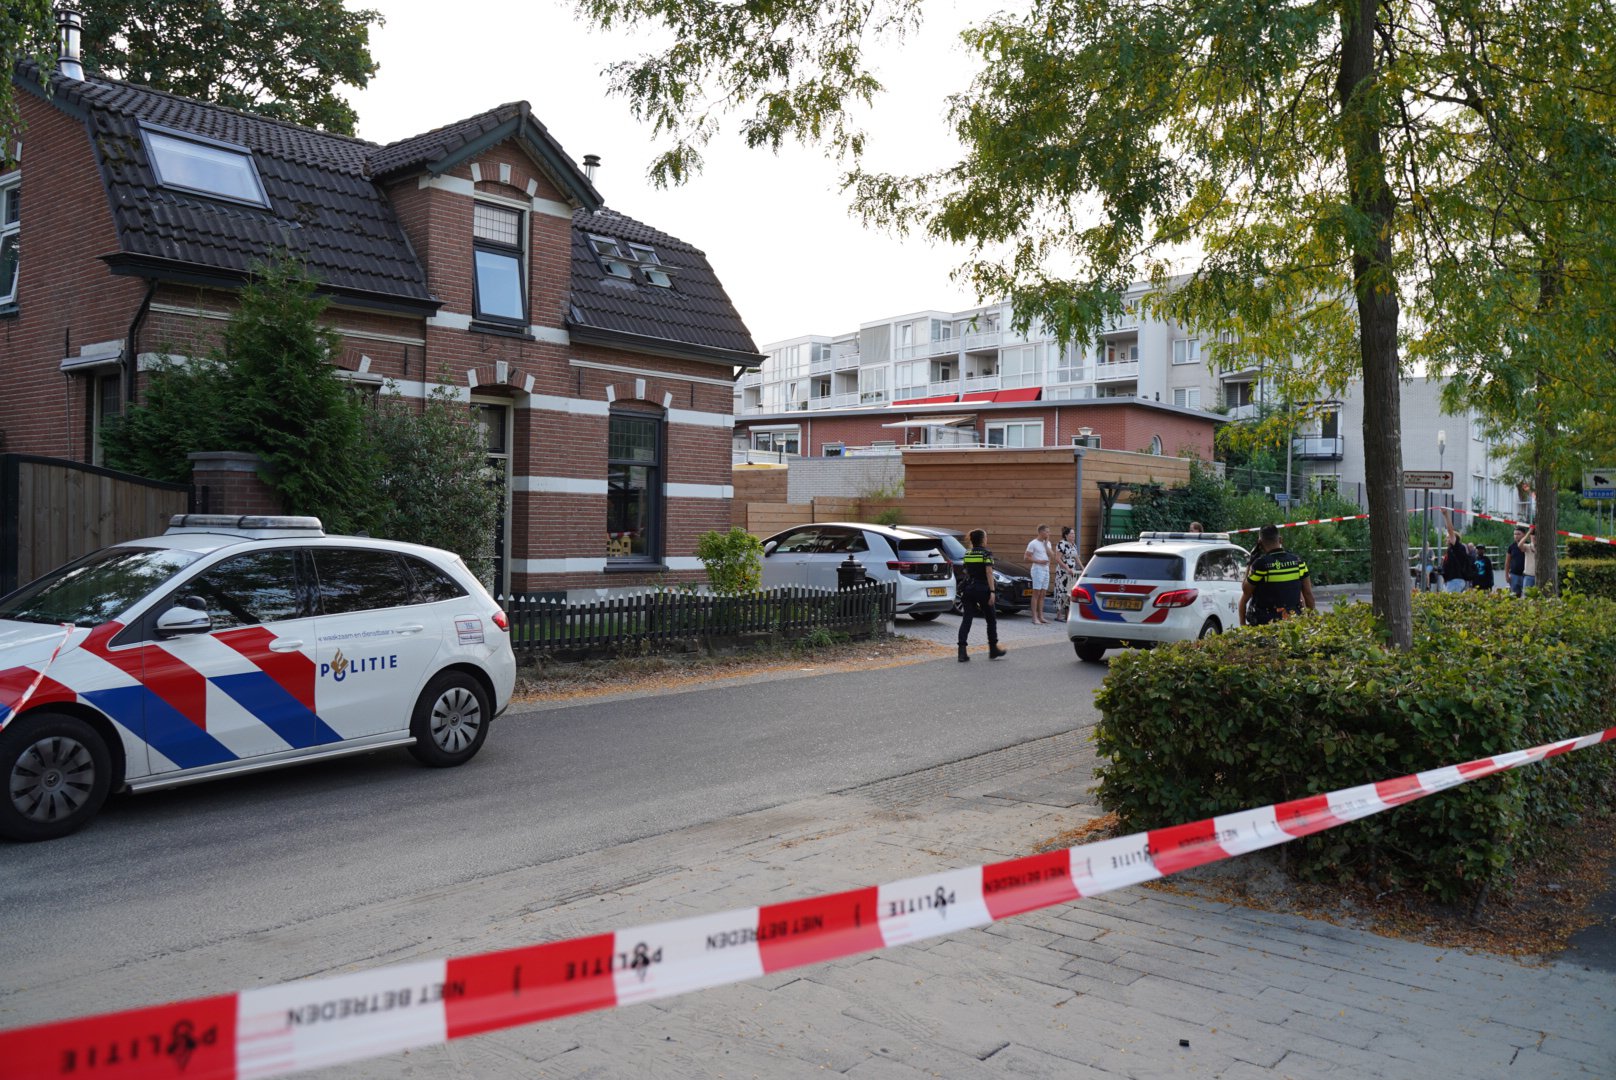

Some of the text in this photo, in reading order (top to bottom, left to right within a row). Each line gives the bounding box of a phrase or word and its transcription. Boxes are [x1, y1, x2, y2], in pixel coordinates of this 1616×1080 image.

[320, 654, 398, 682] POLITIE
[889, 886, 956, 918] POLITIE
[706, 914, 824, 951] NIET BETREDEN
[565, 942, 663, 981] POLITIE
[286, 979, 466, 1027] NIET BETREDEN
[61, 1020, 218, 1075] POLITIE
